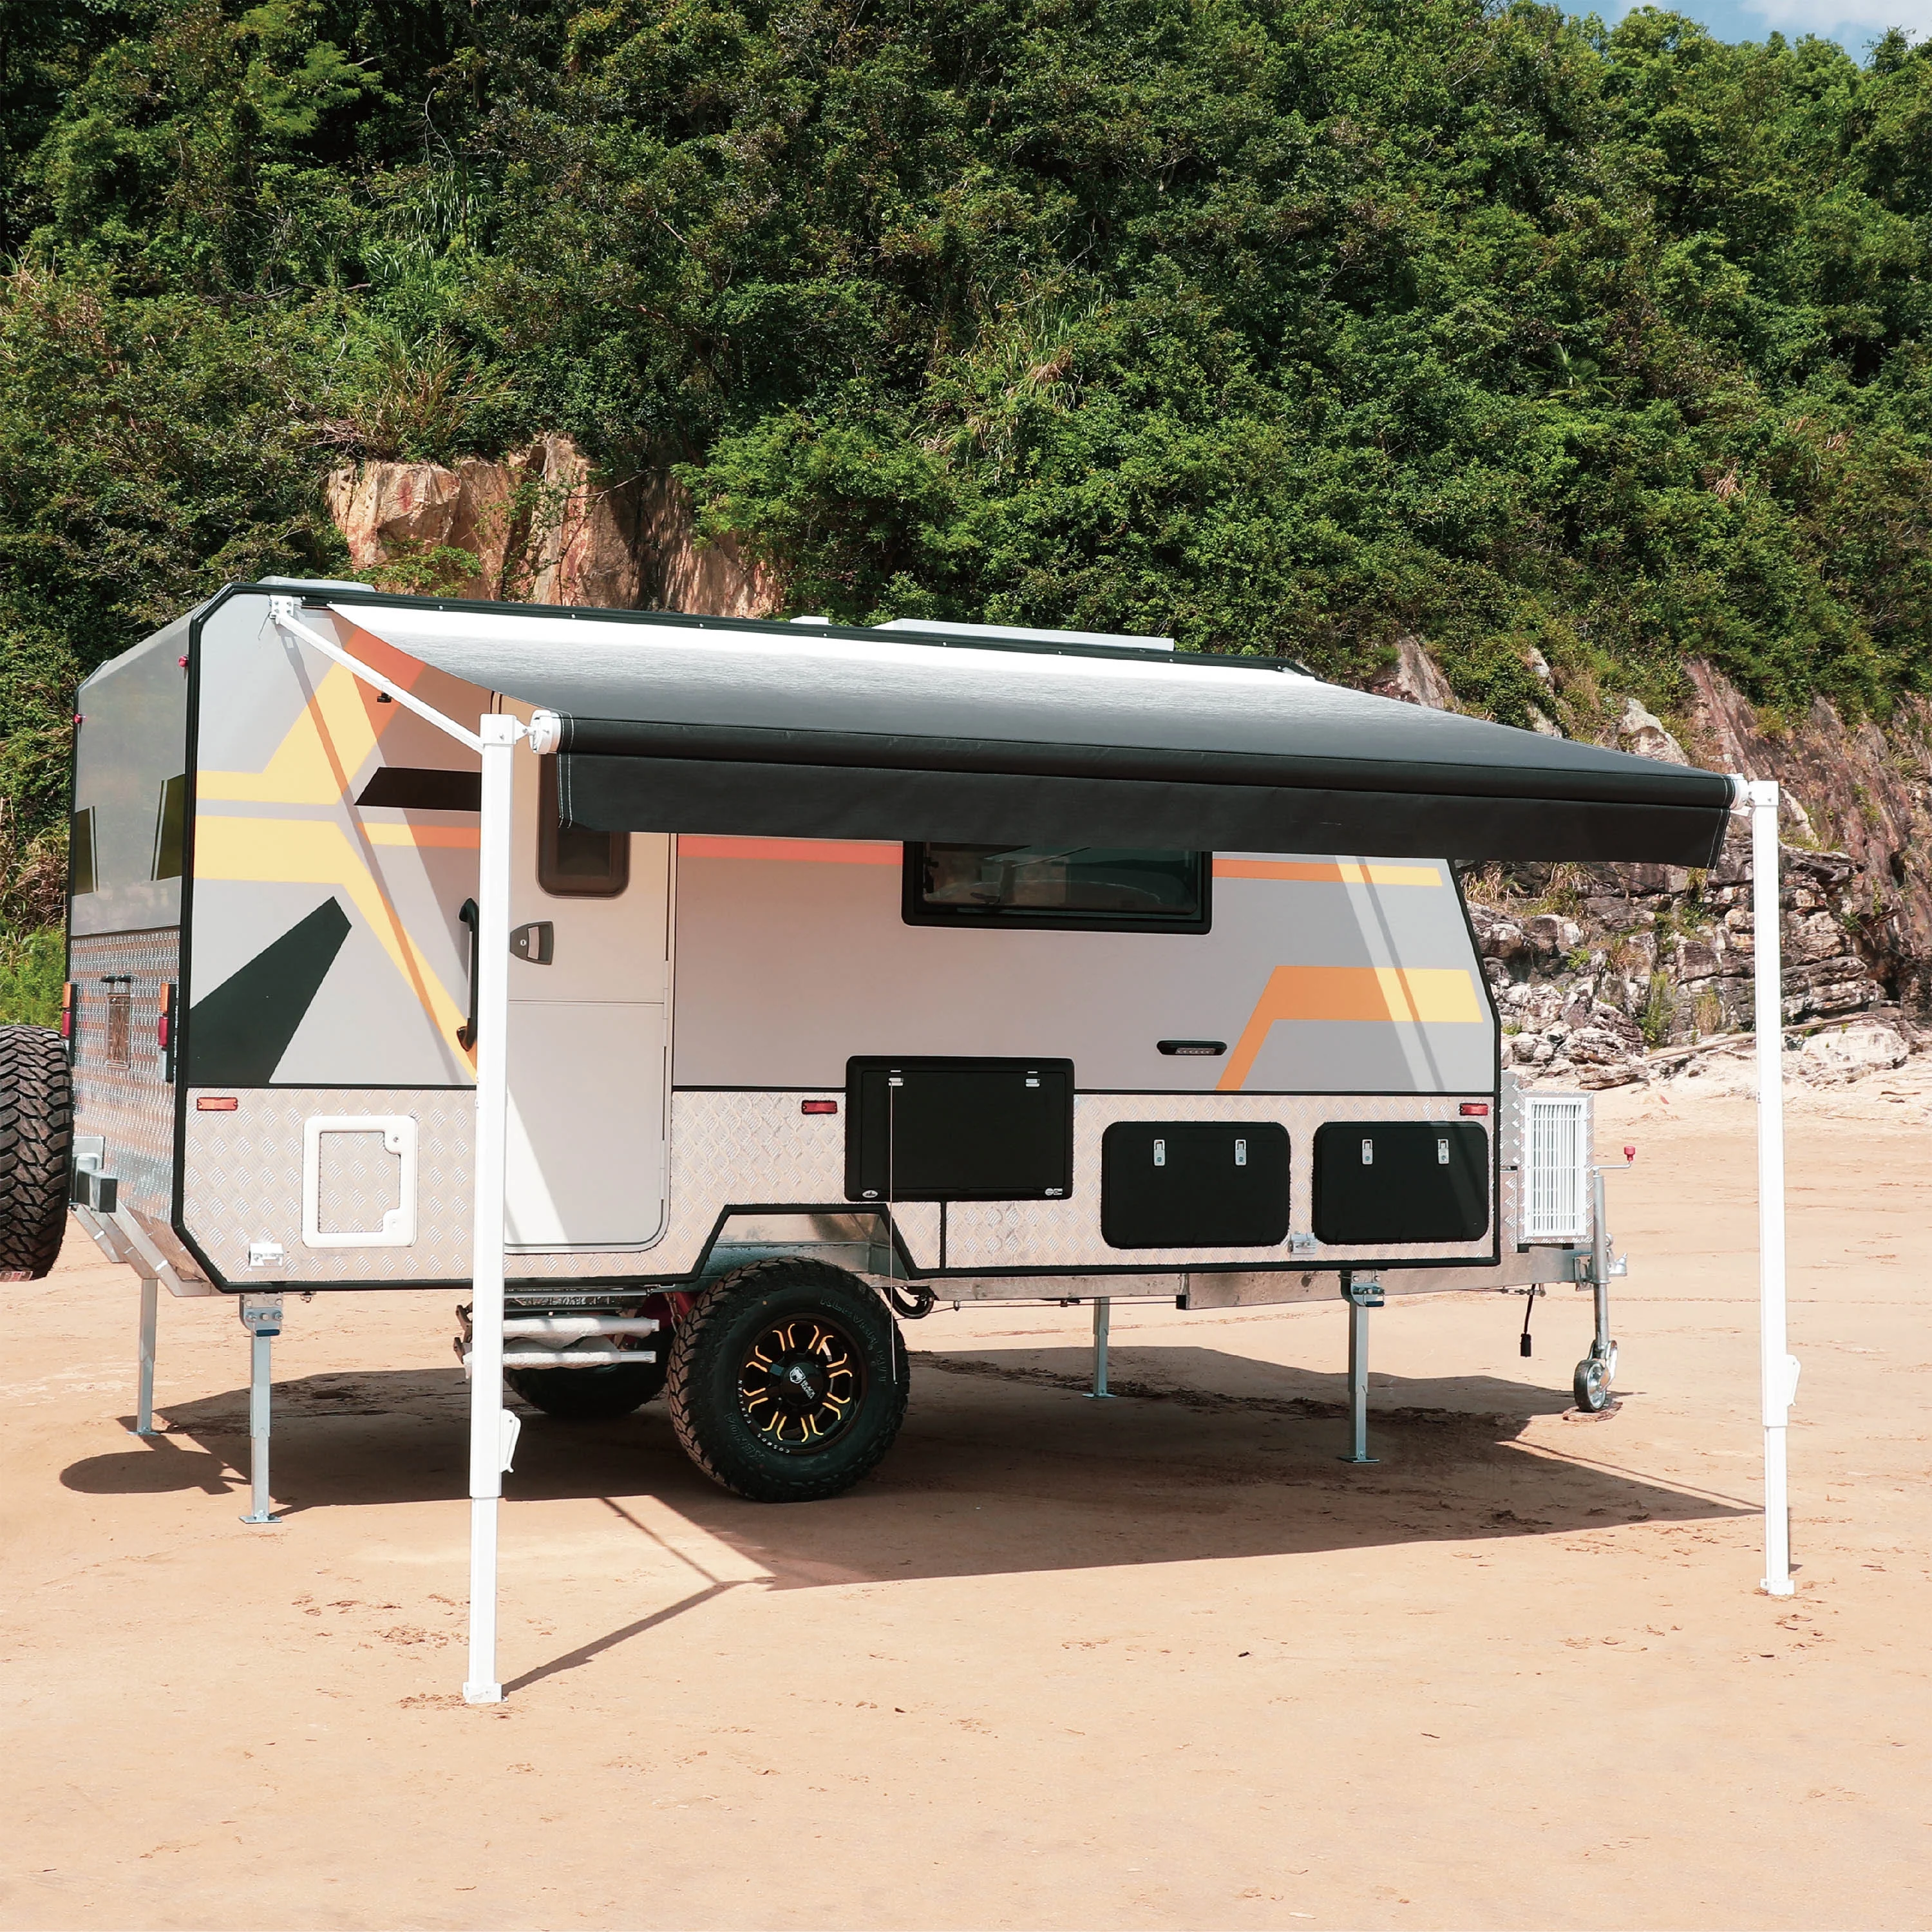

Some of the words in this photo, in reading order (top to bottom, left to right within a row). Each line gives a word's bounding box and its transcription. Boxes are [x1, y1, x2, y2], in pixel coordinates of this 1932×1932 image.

[737, 1379, 752, 1424] CARAVAN
[724, 1412, 766, 1461] KENDA
[757, 1433, 790, 1454] COSMOS
